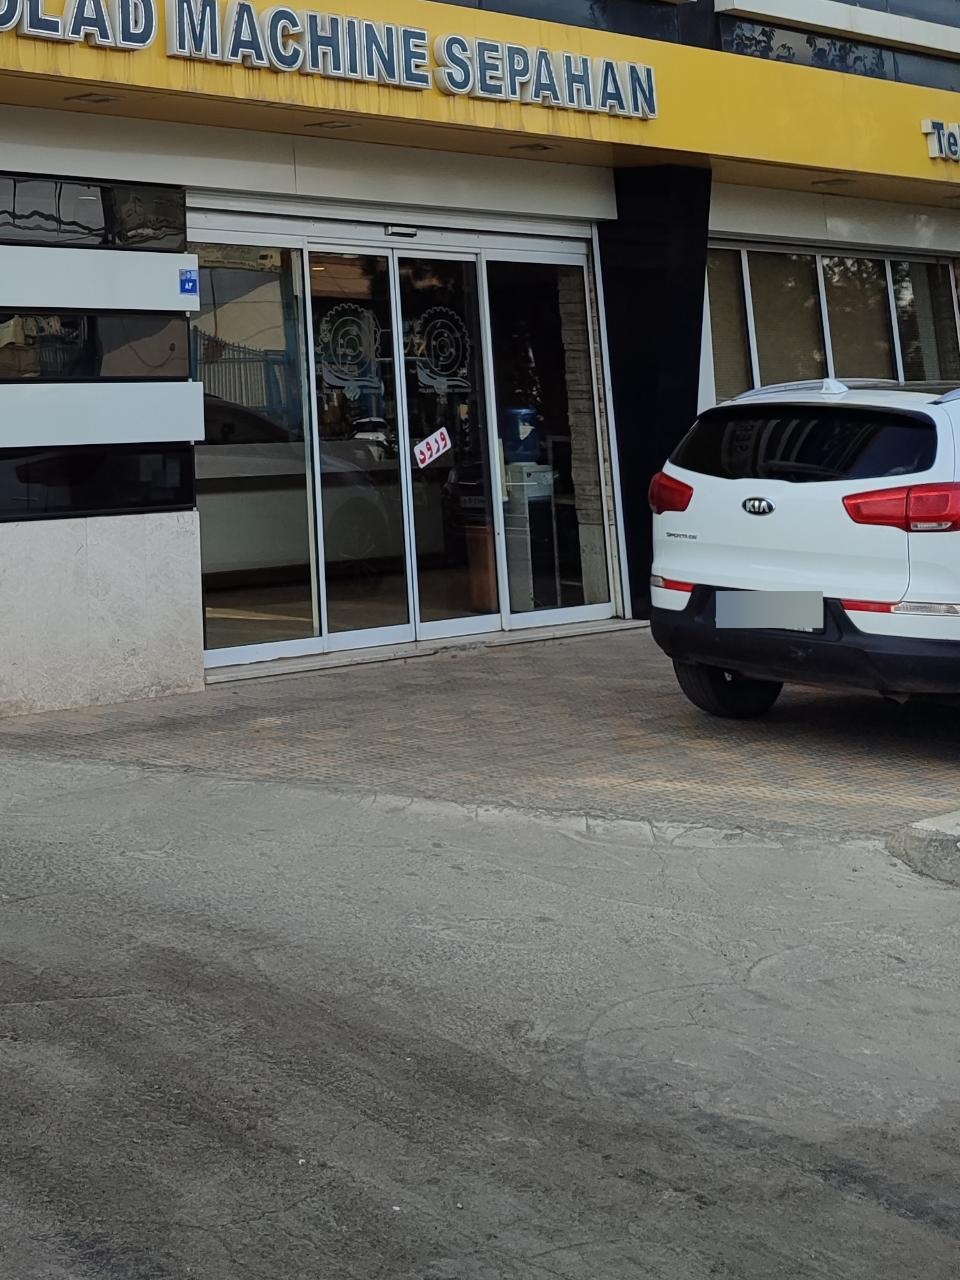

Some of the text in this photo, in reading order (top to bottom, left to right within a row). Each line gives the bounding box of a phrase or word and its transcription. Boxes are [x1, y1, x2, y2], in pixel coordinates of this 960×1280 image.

[434, 34, 657, 119] SEPAHAN
[921, 119, 960, 161] Te
[418, 430, 448, 465] ورود
[745, 499, 770, 513] KIA
